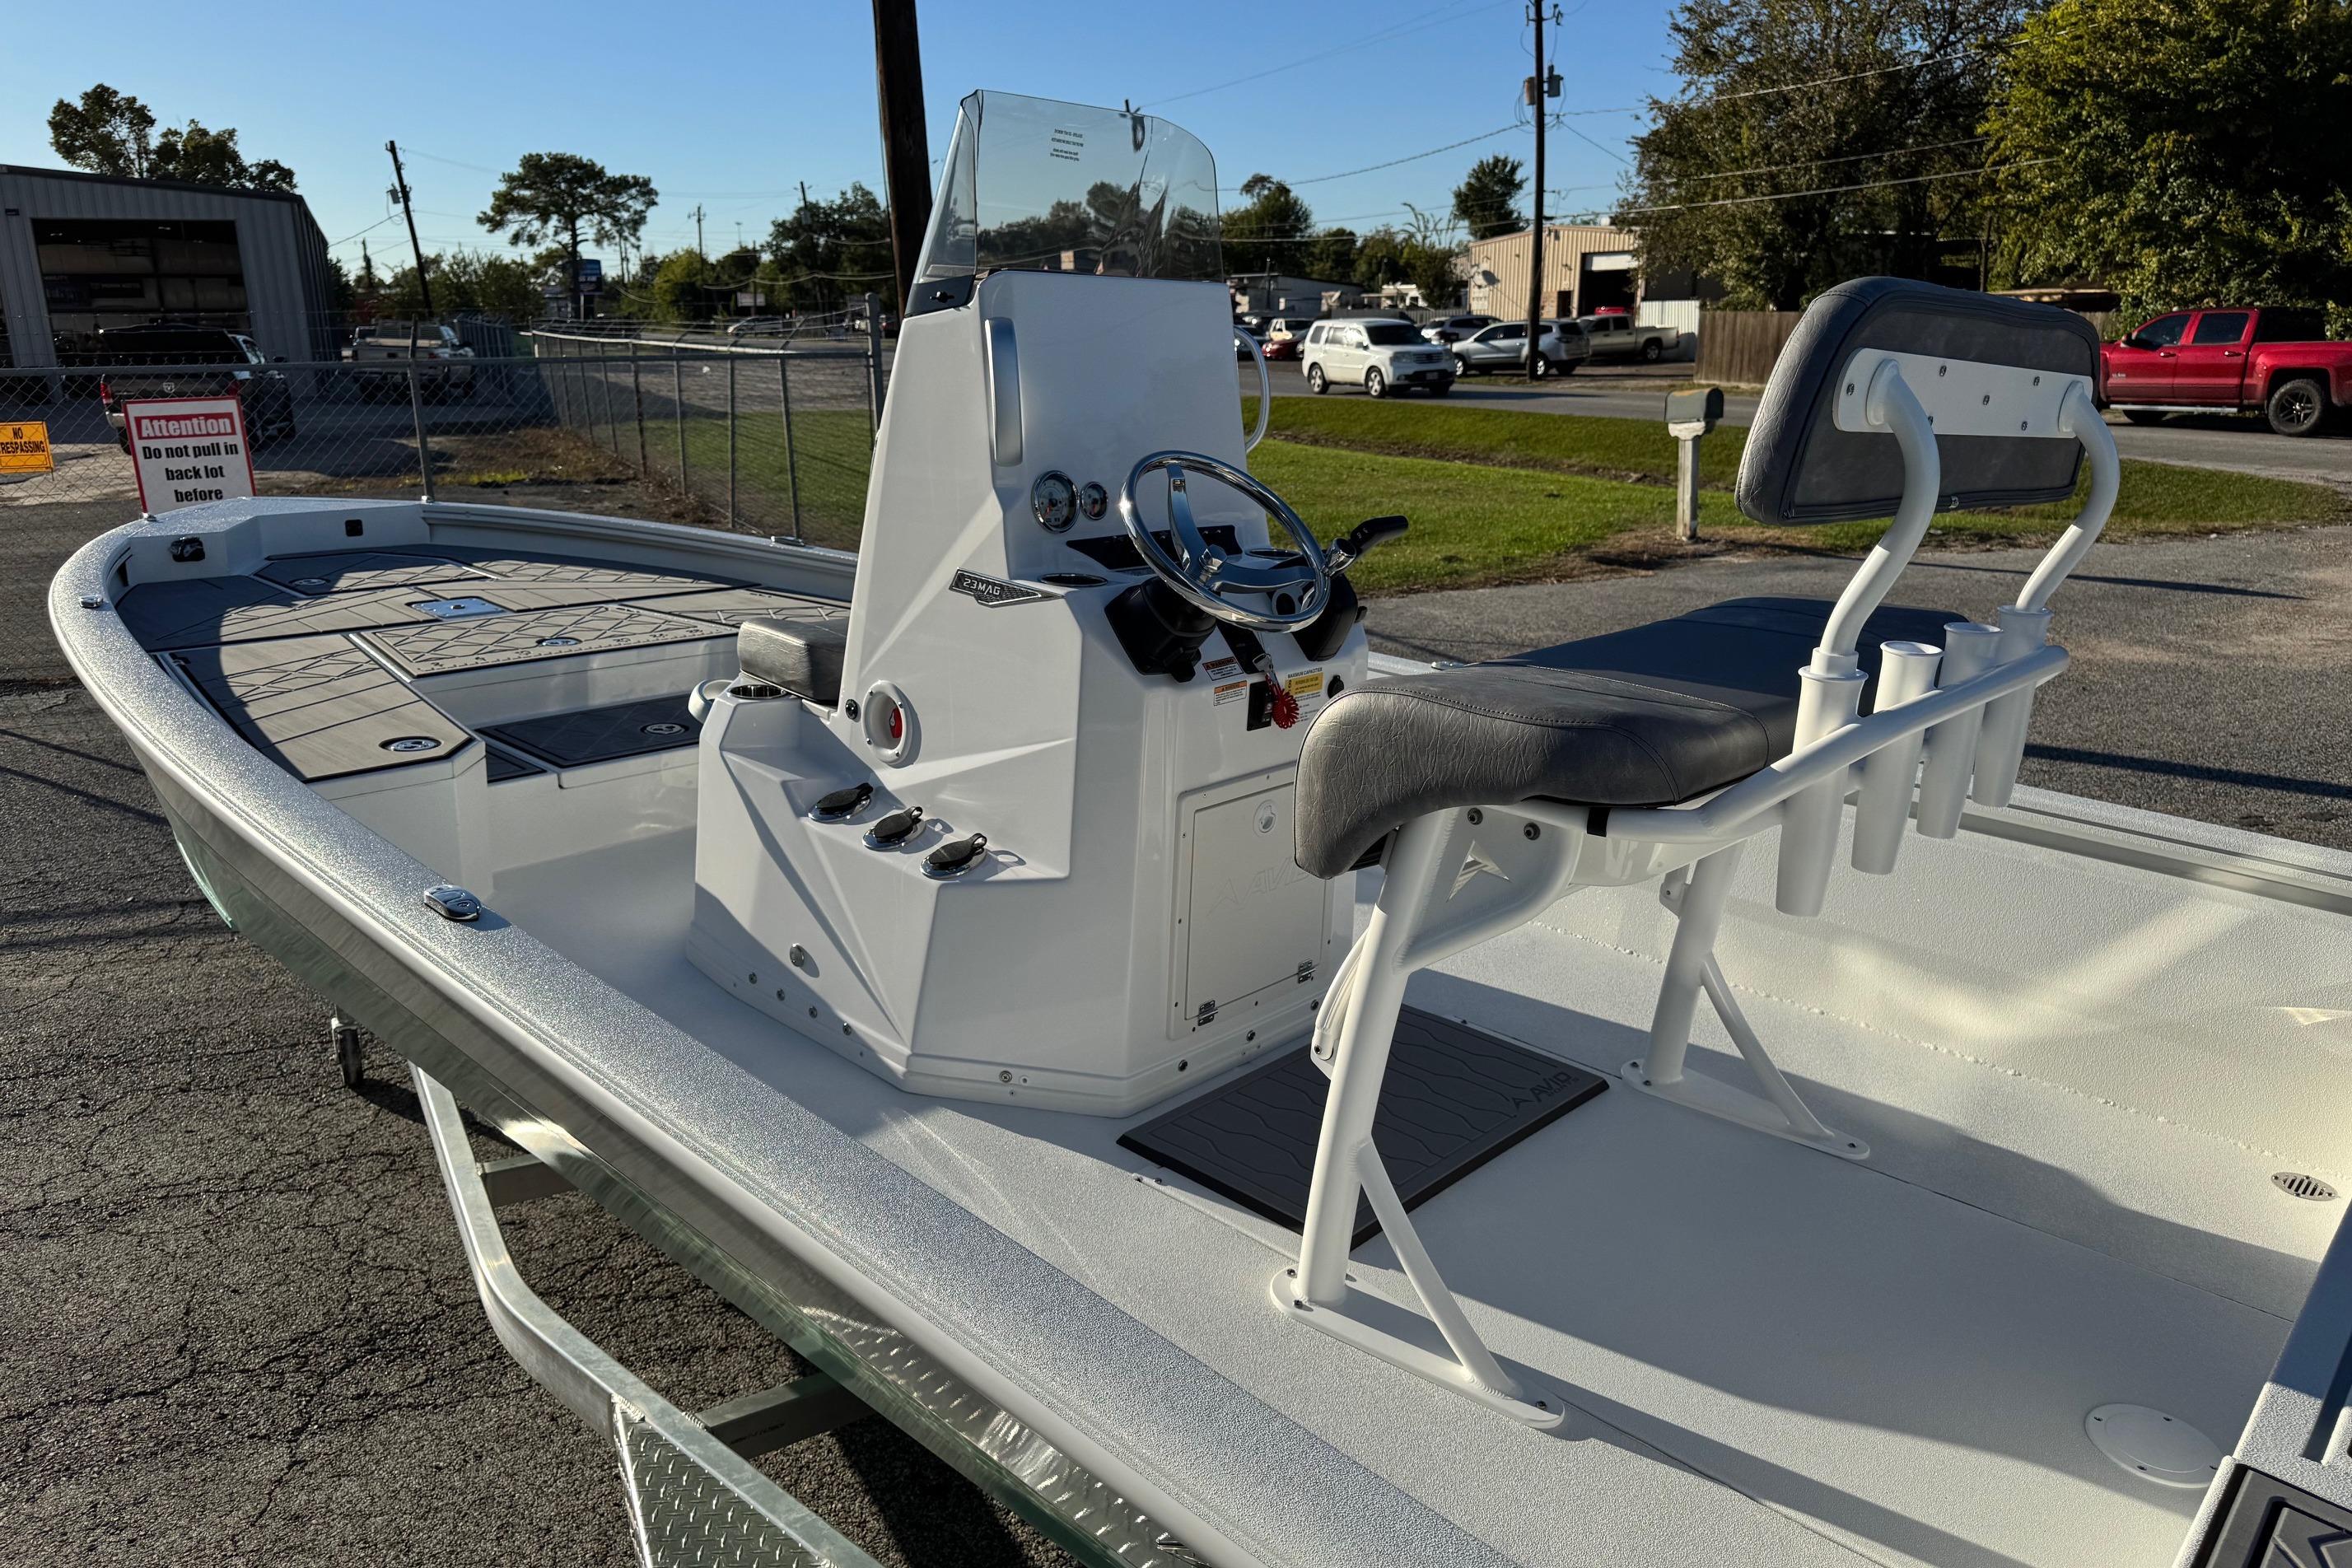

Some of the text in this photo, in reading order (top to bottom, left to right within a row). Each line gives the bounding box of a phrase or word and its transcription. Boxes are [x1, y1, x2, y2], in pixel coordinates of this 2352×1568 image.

[12, 427, 24, 440] NO
[141, 417, 231, 437] Attention
[0, 441, 45, 454] RESPASSING
[142, 441, 239, 460] Do not pull in
[166, 465, 225, 481] back lot
[174, 488, 223, 502] before
[963, 578, 1001, 595] 23MAG
[1528, 1071, 1572, 1103] AVID
